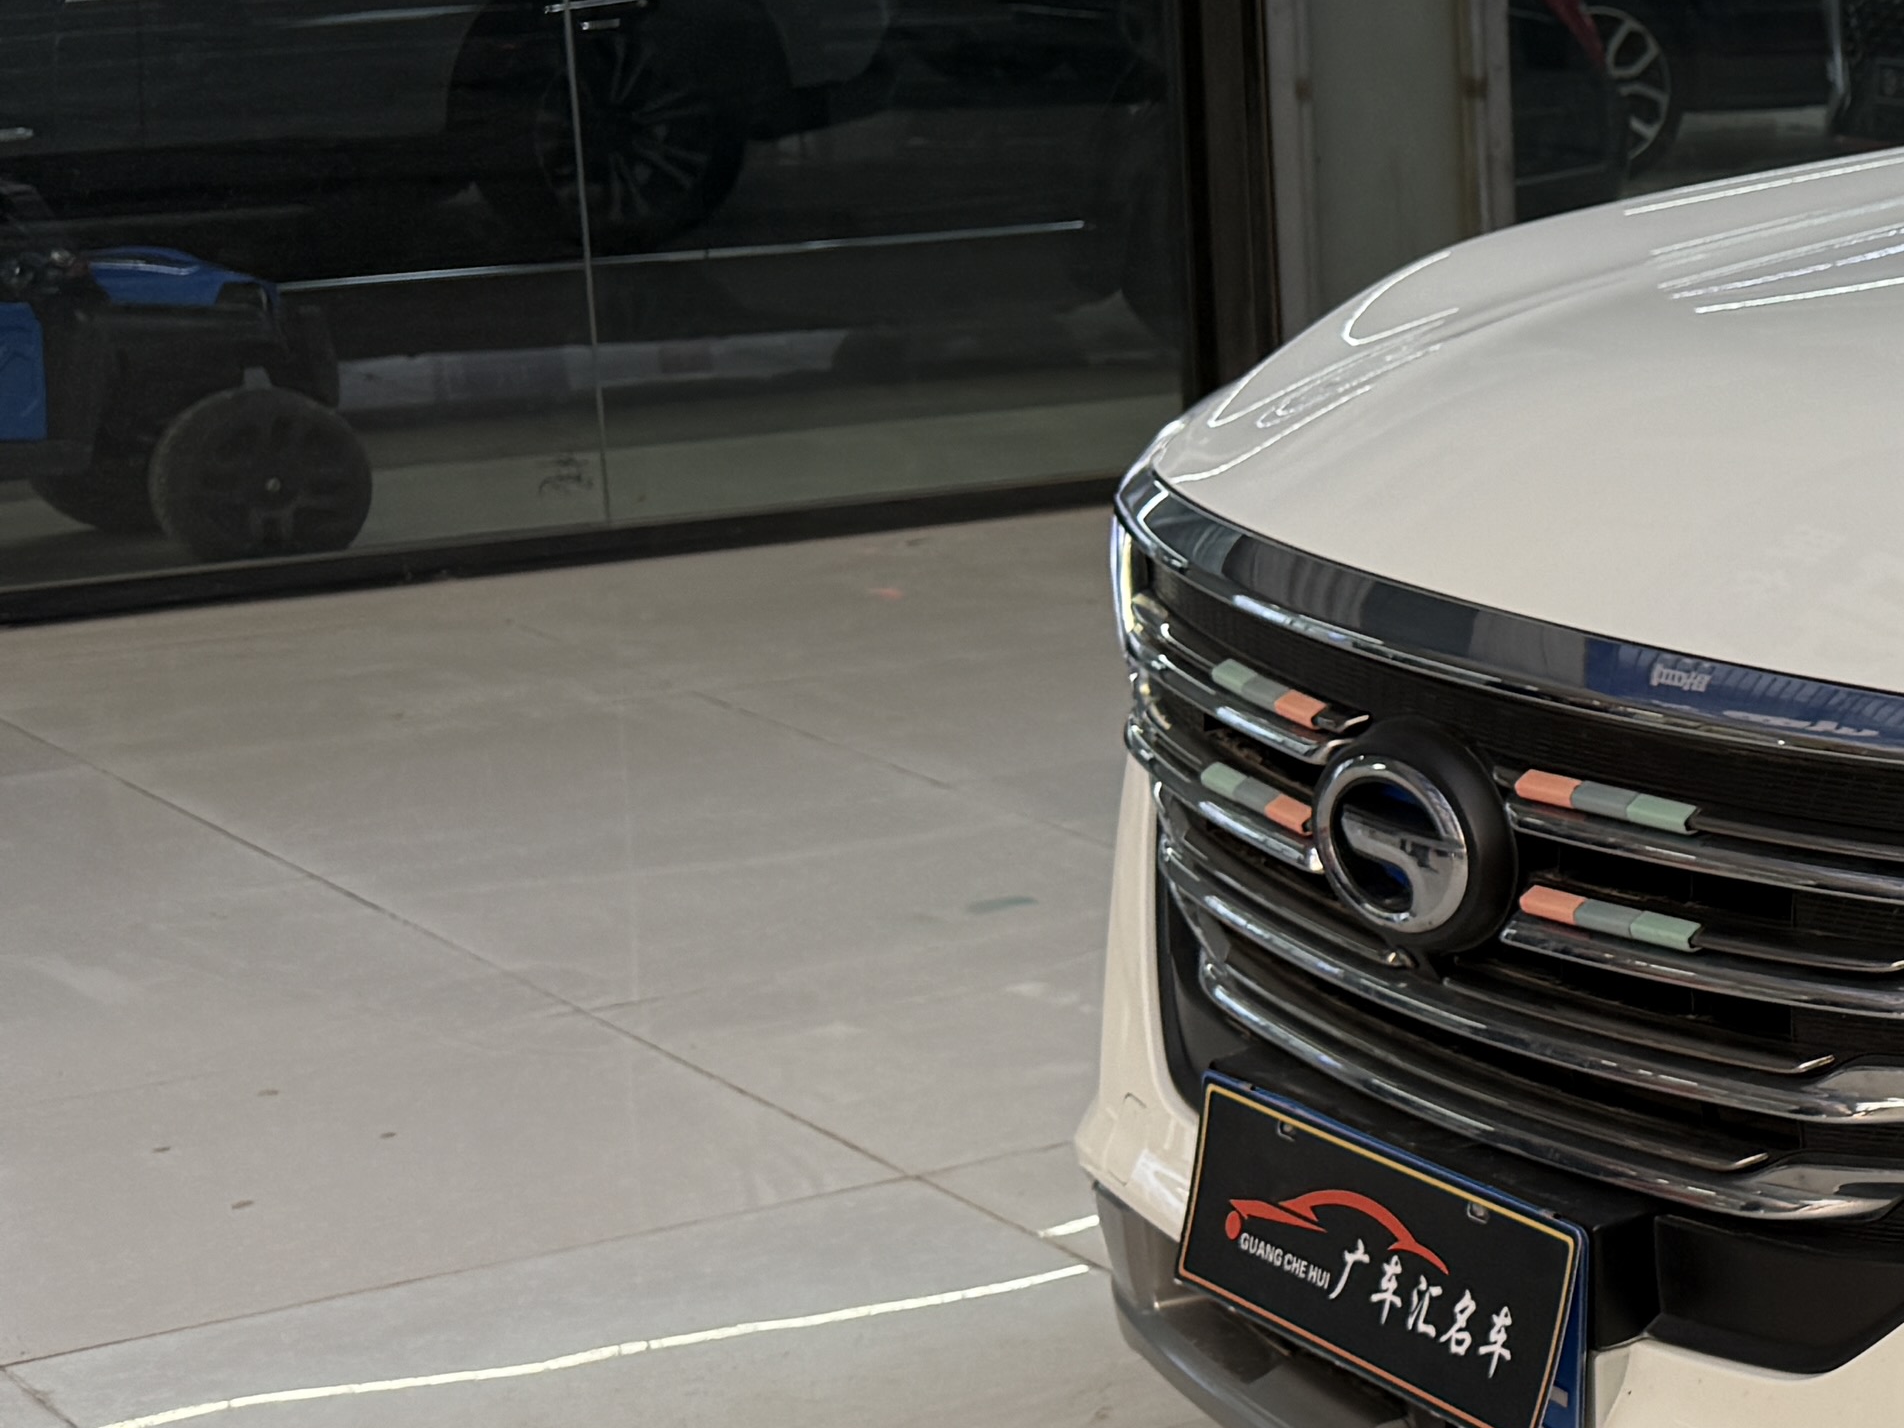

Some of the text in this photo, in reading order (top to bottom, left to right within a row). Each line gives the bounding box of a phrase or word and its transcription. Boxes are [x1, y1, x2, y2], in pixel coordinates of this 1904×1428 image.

[1240, 1232, 1331, 1290] GUANG CHE HUI
[1329, 1238, 1513, 1379] 广车汇名车
